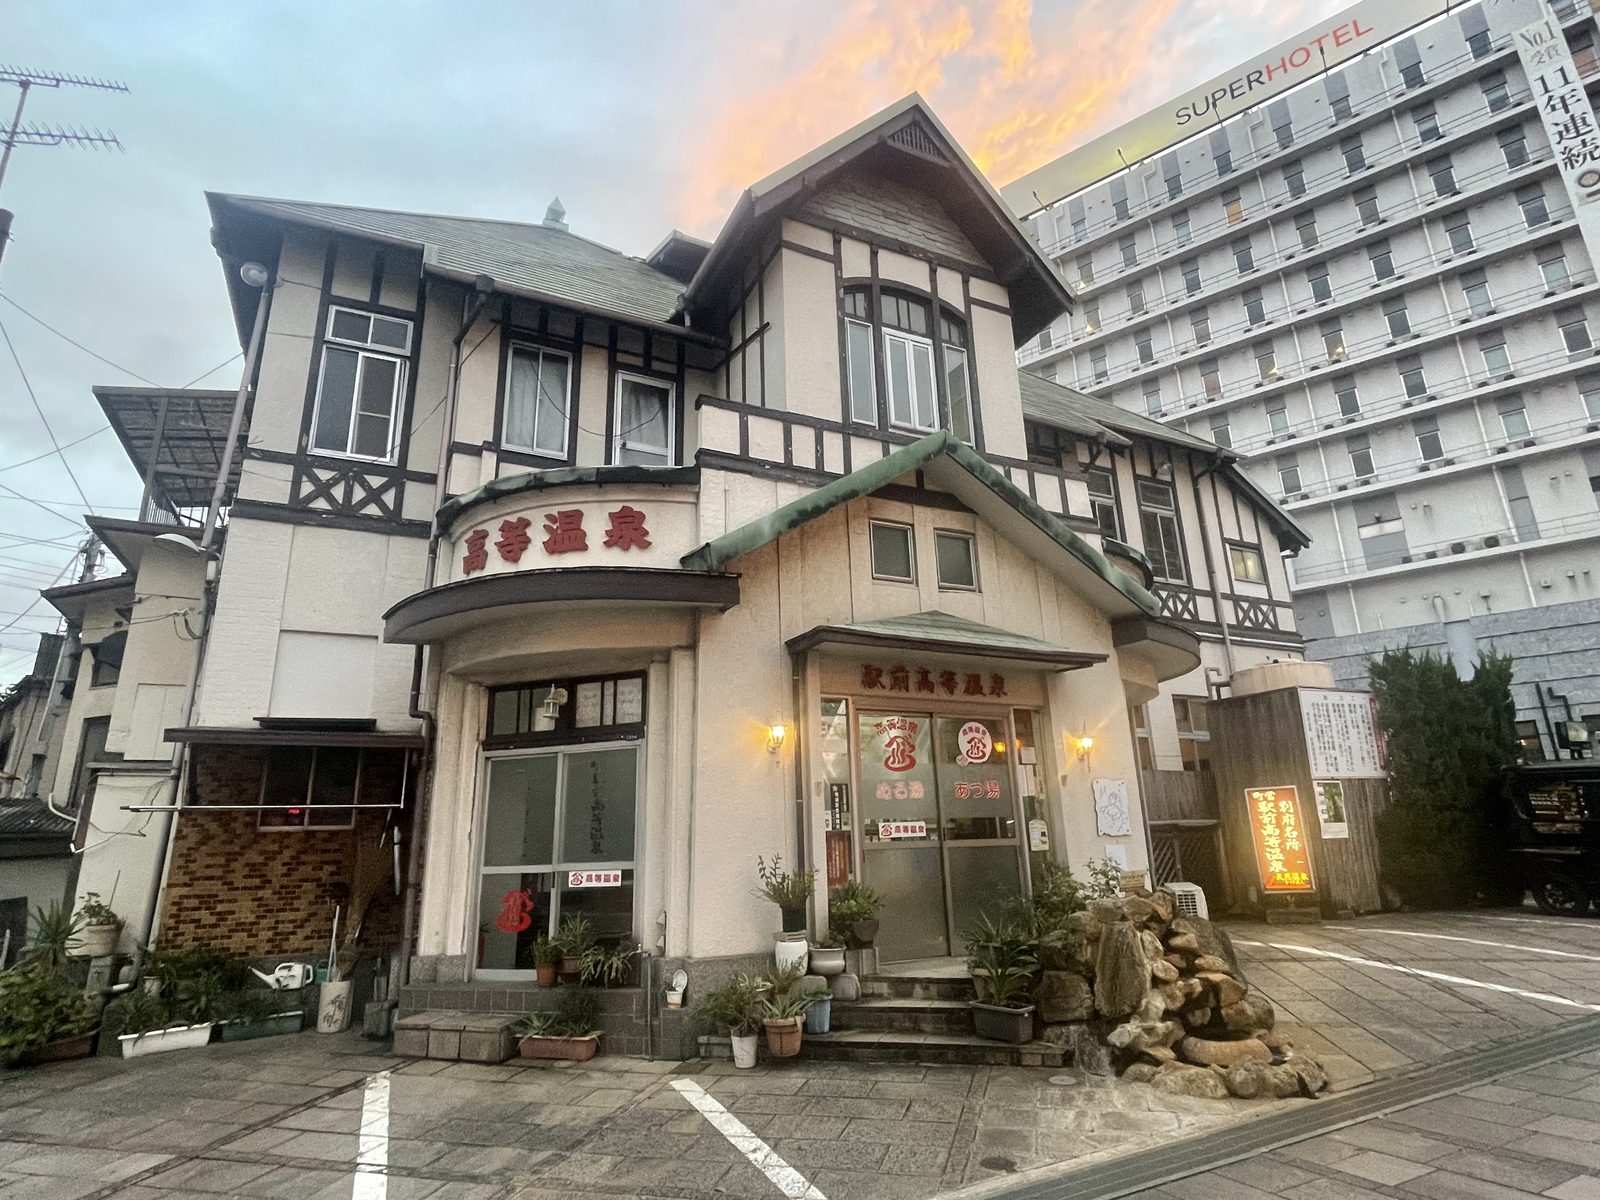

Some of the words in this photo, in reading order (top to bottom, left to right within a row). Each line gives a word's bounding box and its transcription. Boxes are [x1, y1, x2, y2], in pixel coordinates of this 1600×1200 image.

[1519, 20, 1557, 48] No.1
[462, 505, 652, 575] 高等温泉
[860, 664, 1008, 698] 駅前高等温泉
[873, 717, 918, 736] 高等温泉
[876, 781, 925, 800] ぬる湯
[954, 780, 1000, 799] あつ湯
[894, 825, 925, 834] 高等温泉
[1257, 801, 1288, 872] 駅前高等温泉
[1278, 800, 1301, 851] 別府名所
[586, 873, 620, 883] 高等温泉
